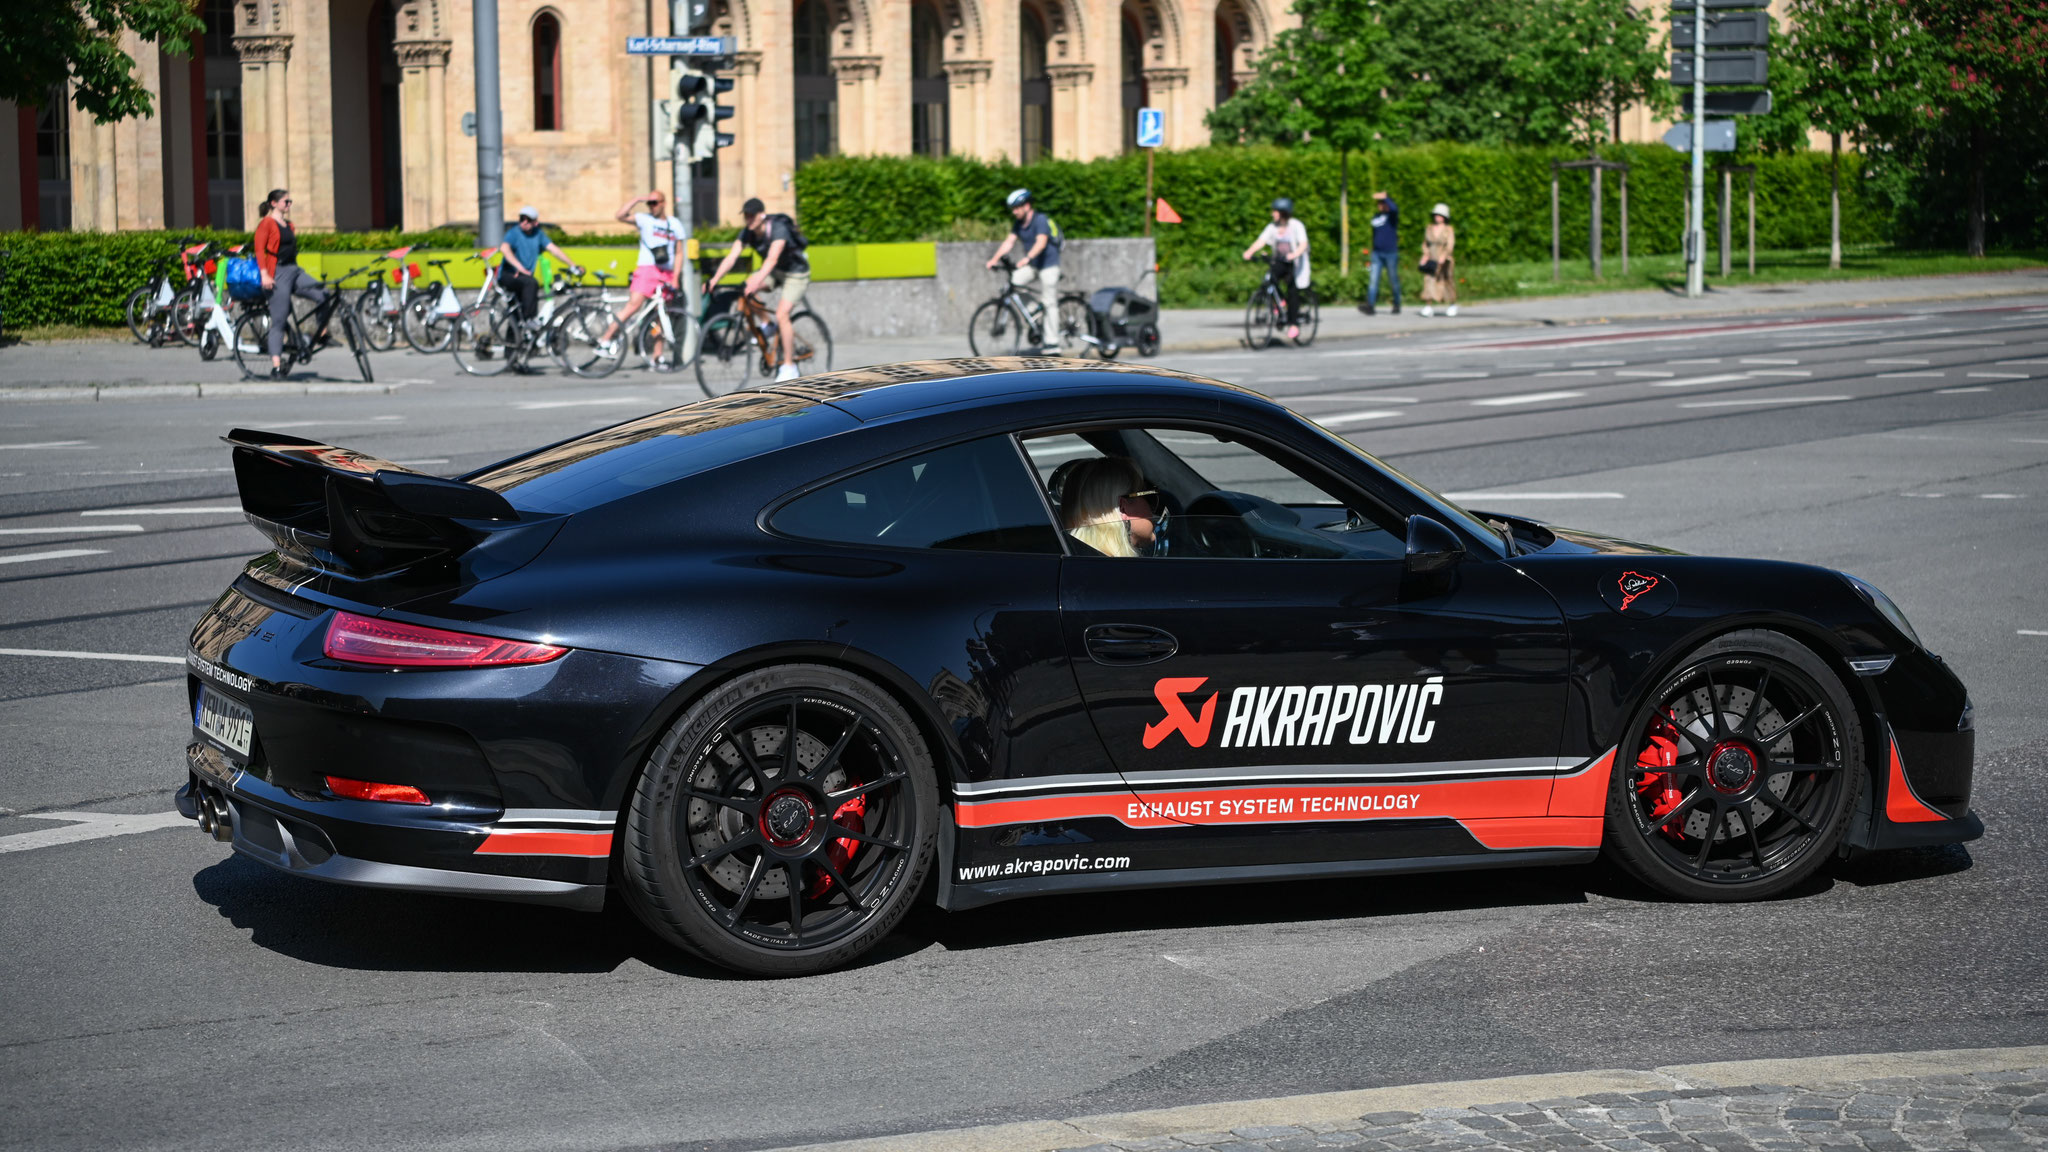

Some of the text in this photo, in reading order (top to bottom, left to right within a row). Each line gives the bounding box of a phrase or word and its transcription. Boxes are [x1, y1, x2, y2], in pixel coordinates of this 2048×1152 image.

[197, 657, 213, 677] SYSTEM
[213, 665, 253, 693] TECHNOLOGY
[680, 688, 741, 753] MICHELIN
[686, 755, 703, 783] RACING
[1127, 794, 1420, 819] EXHAUST SYSTEM TECHNOLOGY
[888, 858, 905, 886] RACING
[959, 854, 1131, 881] www.akrapovic.com
[696, 888, 717, 912] FORGED
[742, 930, 761, 940] MADE
